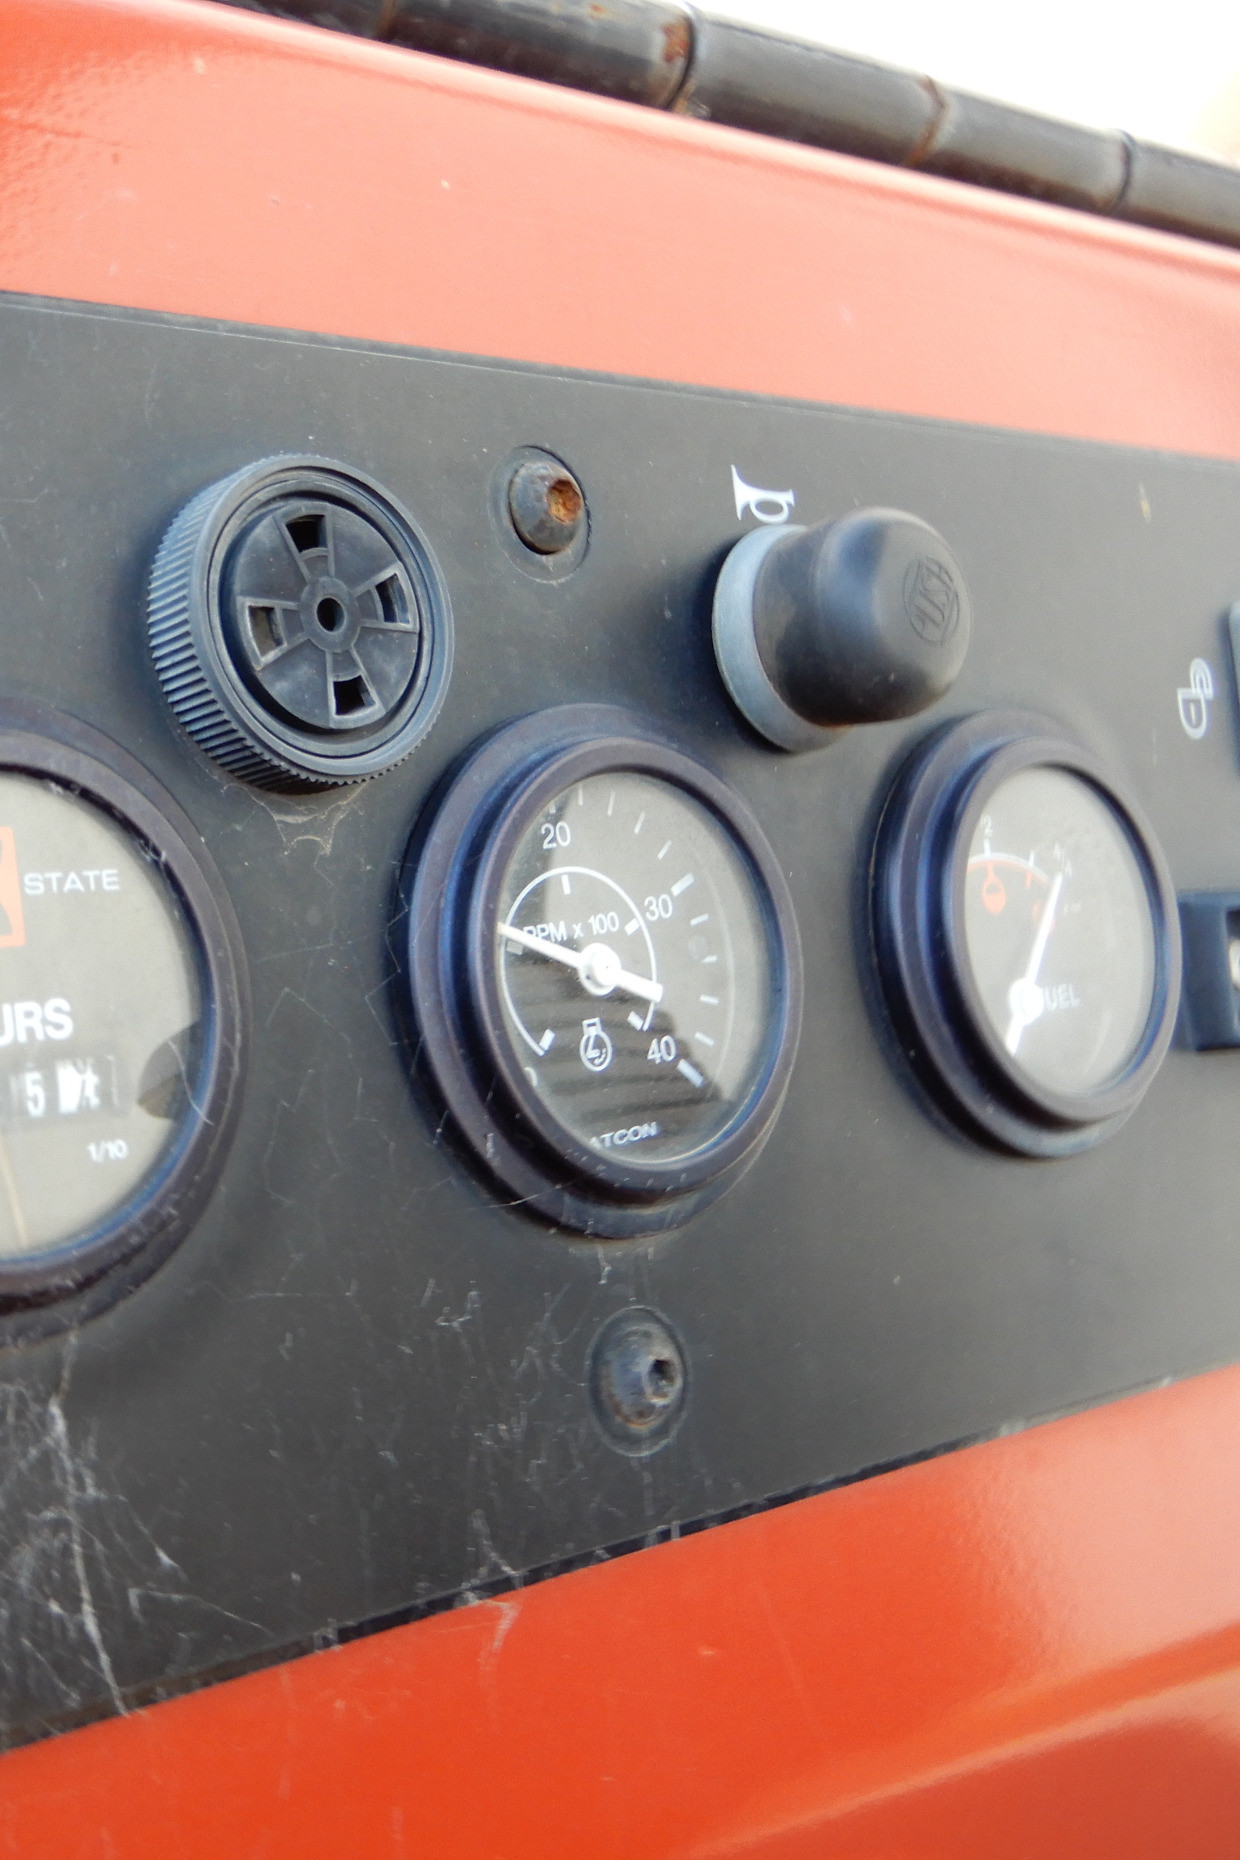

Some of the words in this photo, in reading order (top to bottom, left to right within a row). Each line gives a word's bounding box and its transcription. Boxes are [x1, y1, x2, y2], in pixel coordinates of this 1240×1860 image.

[541, 820, 571, 850] 20
[23, 868, 120, 896] STATE
[644, 895, 674, 923] 30
[588, 911, 620, 936] 100
[1043, 984, 1081, 1012] UEL
[647, 1035, 677, 1064] 40
[87, 1139, 128, 1163] 1/10
